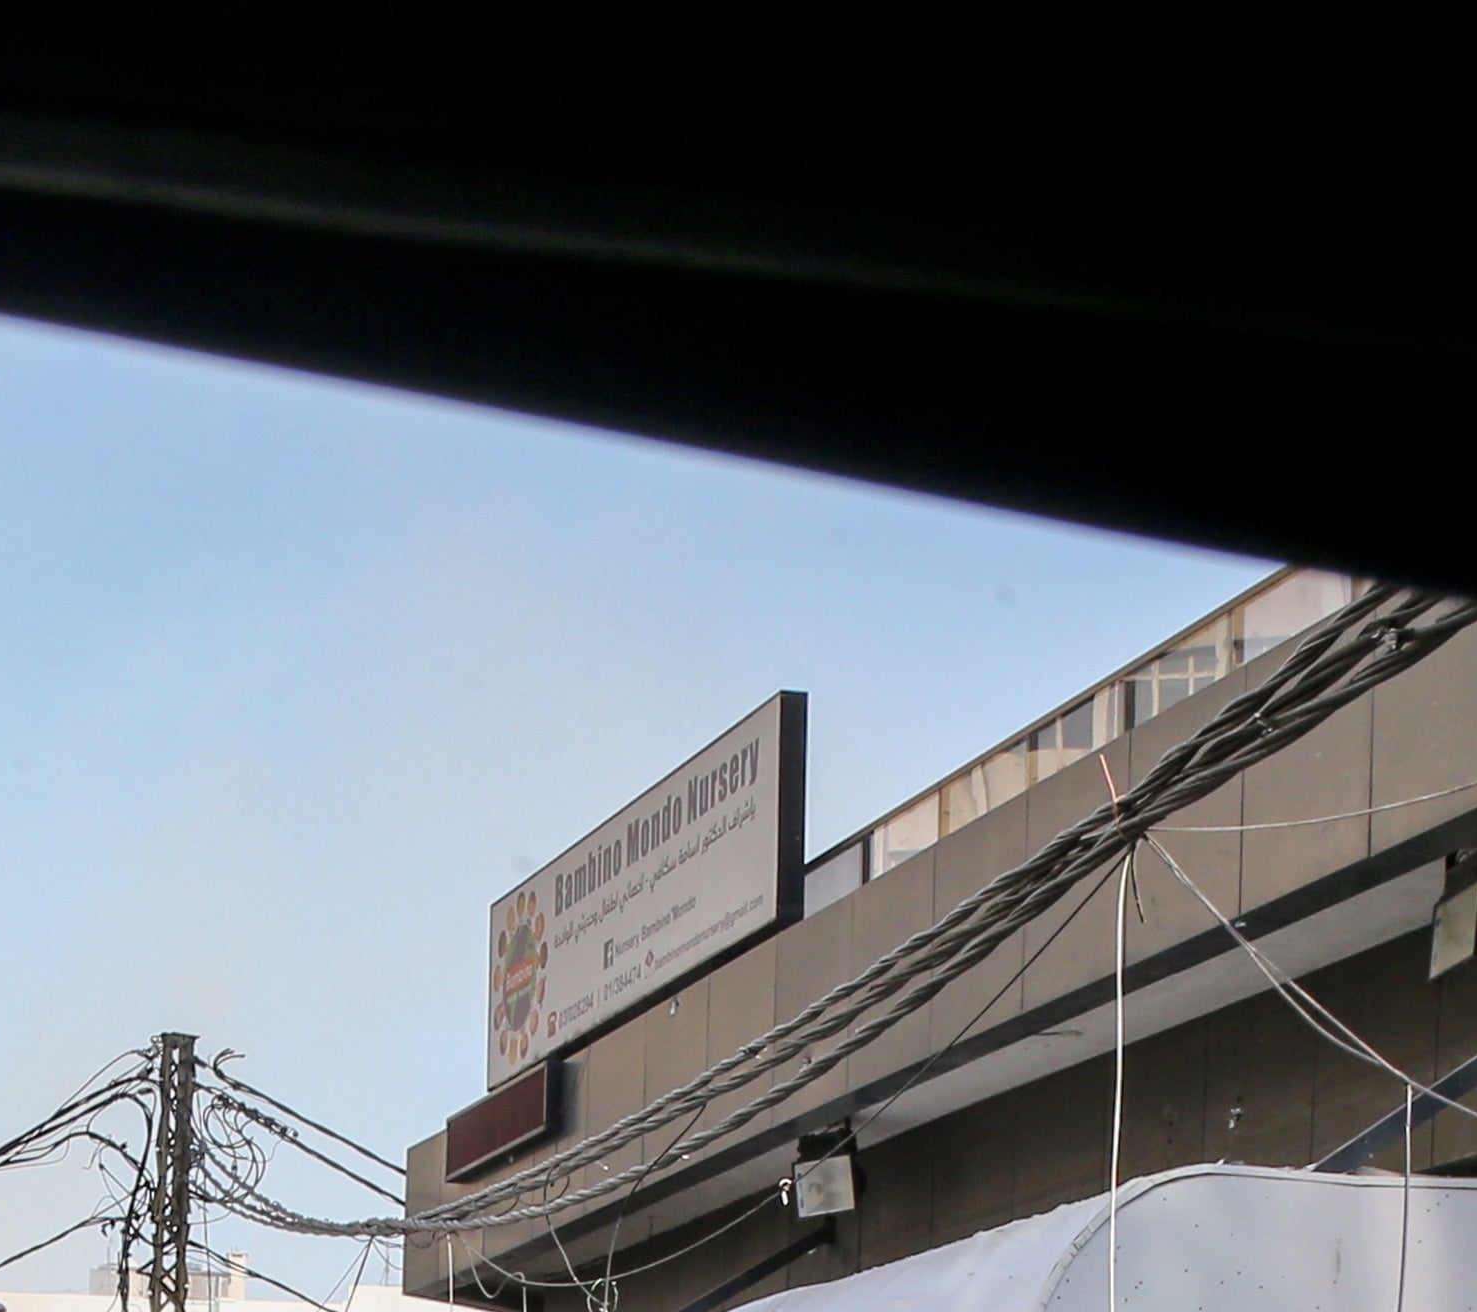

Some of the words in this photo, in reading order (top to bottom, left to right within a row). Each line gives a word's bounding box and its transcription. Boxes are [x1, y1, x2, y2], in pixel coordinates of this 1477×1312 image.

[555, 839, 622, 917] Bambino
[627, 795, 682, 868] Mondo
[687, 737, 760, 826] Nursery
